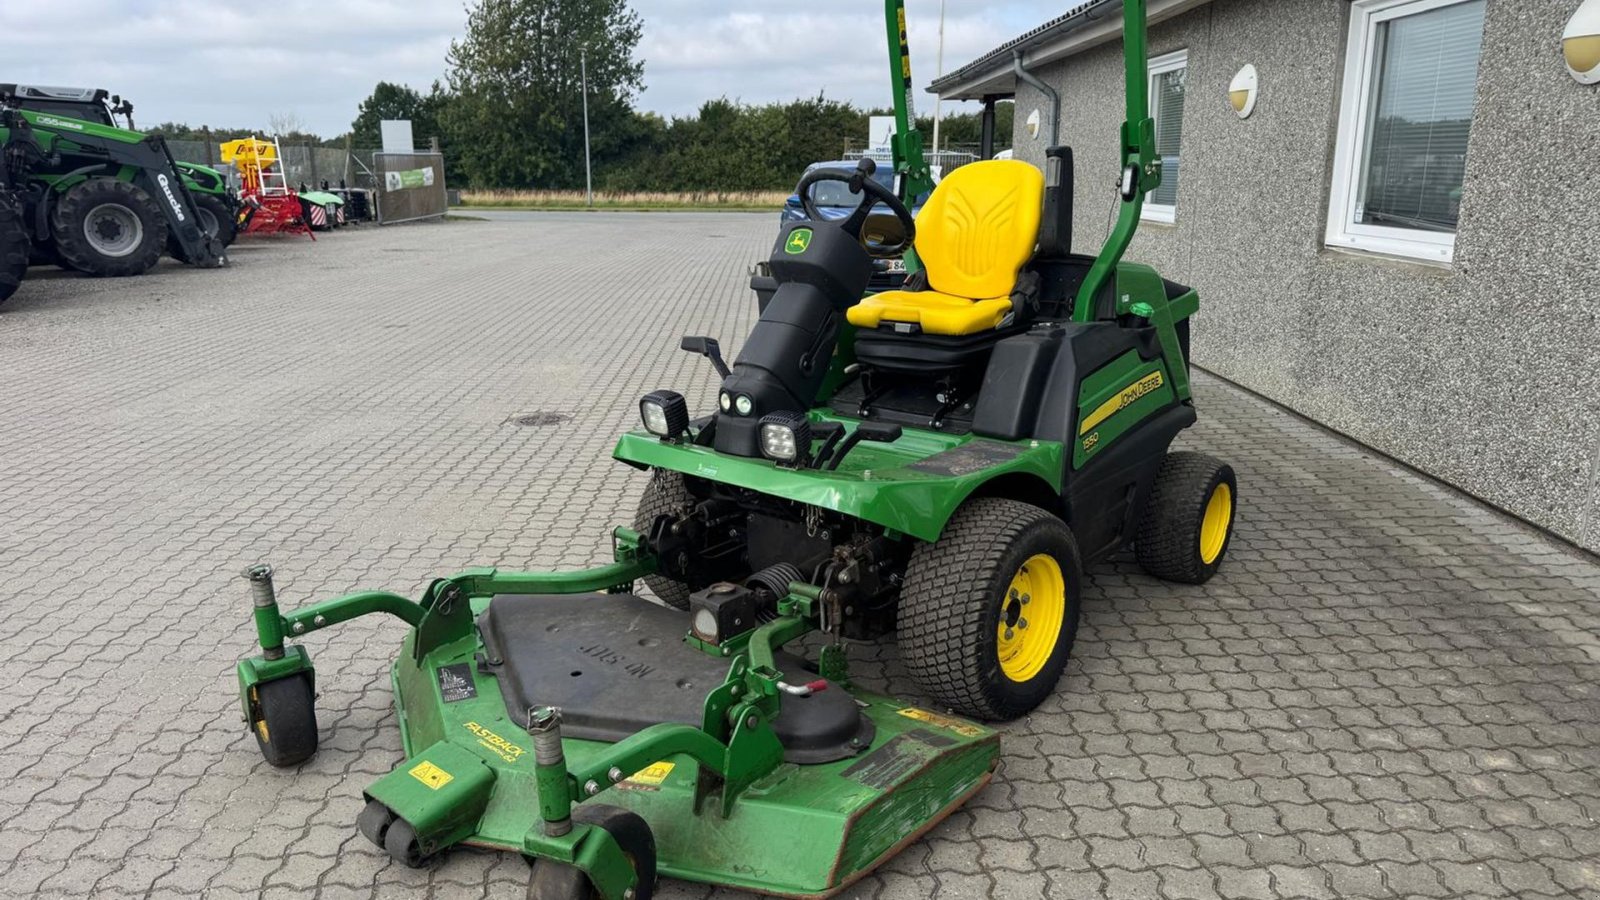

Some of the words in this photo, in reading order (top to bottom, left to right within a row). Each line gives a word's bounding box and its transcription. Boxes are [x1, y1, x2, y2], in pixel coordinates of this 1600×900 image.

[157, 173, 185, 221] Quicke
[1119, 387, 1139, 408] JOHN
[1137, 375, 1160, 397] DEERE
[1083, 431, 1098, 450] 1550
[463, 721, 527, 757] FASTBACK
